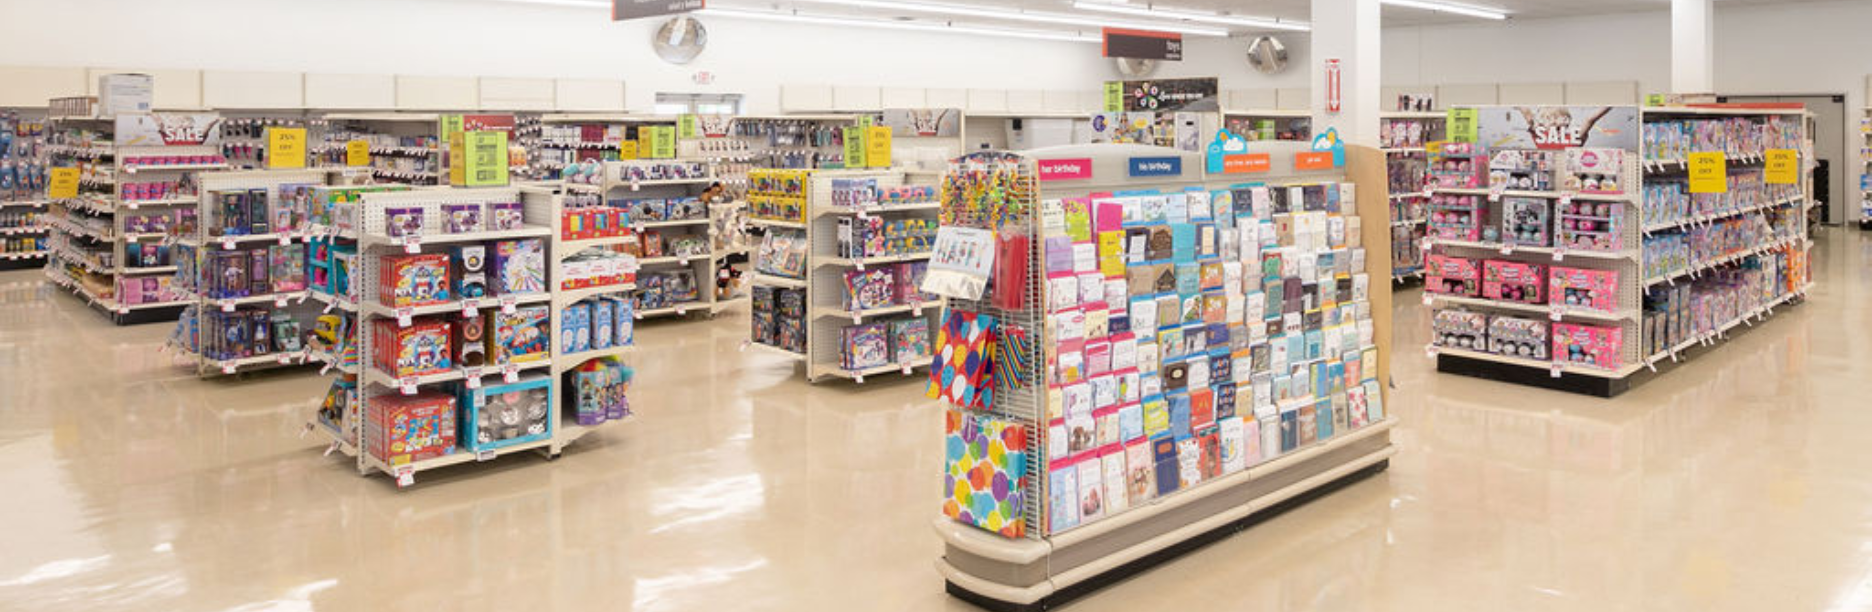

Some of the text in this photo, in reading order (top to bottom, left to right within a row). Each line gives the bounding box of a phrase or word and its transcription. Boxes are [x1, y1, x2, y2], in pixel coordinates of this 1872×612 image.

[165, 127, 204, 141] SALE
[1535, 126, 1582, 145] SALE
[1041, 164, 1081, 175] her birthday
[1148, 161, 1172, 171] birthday
